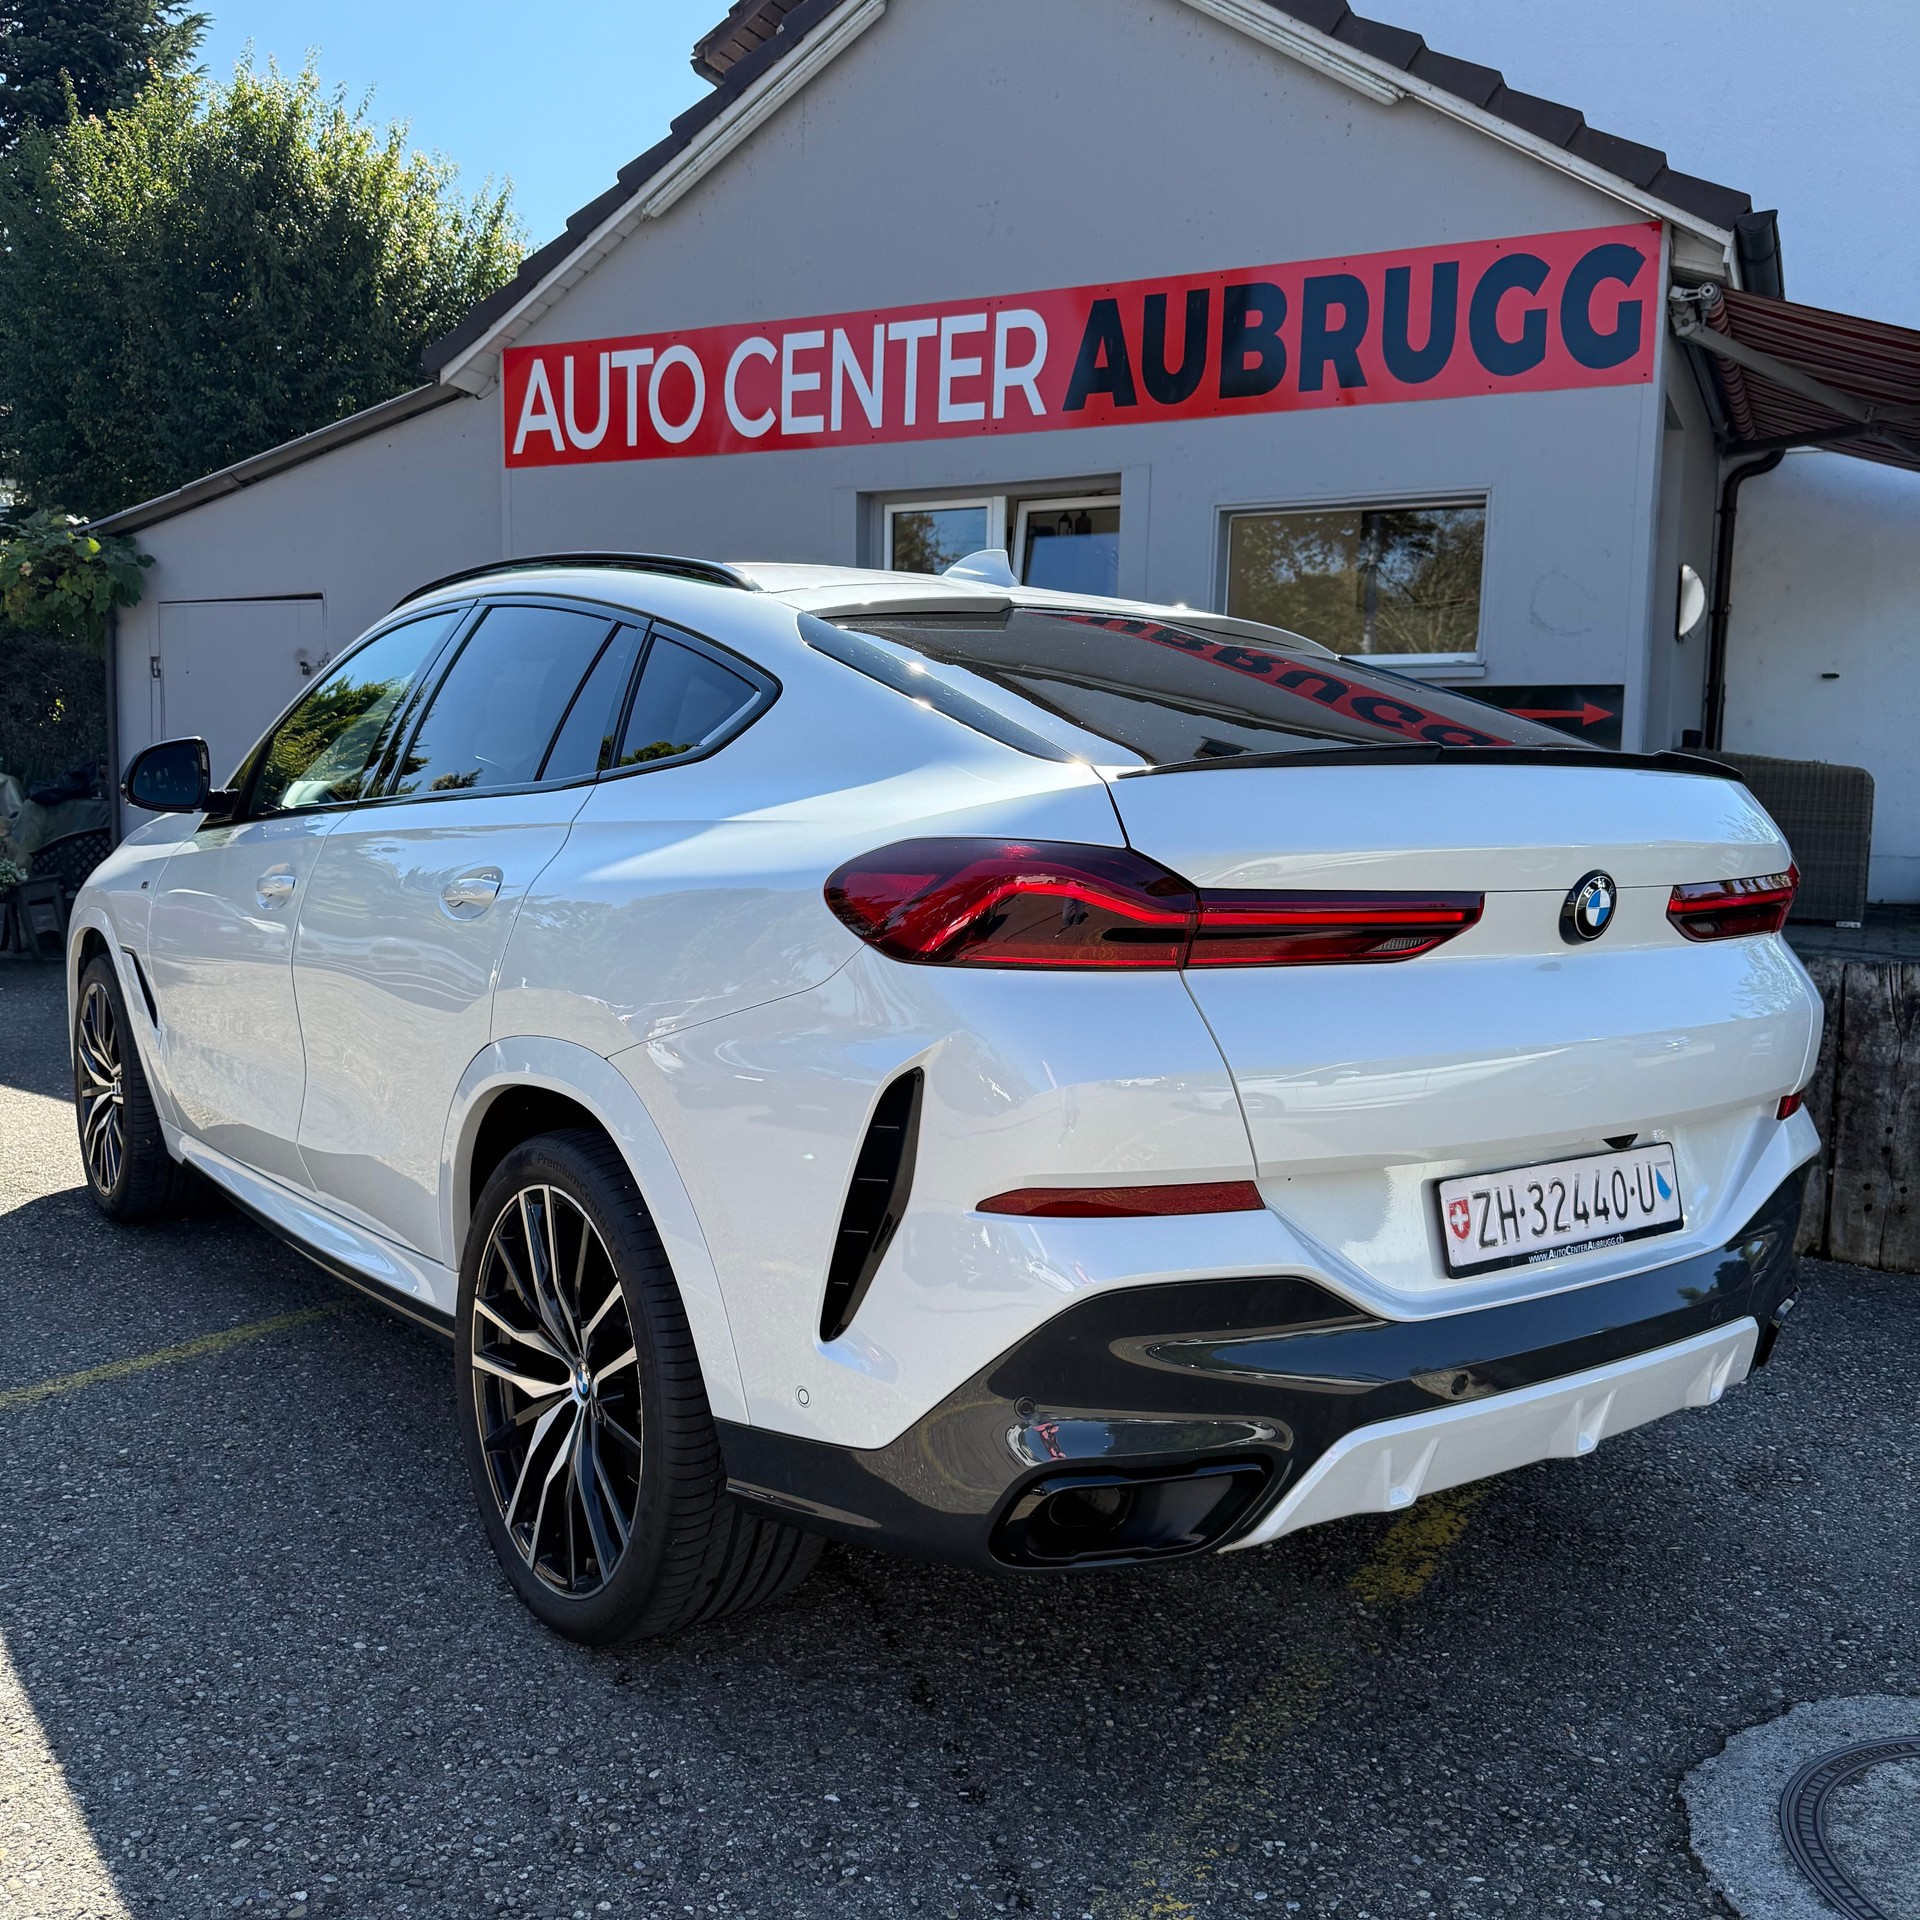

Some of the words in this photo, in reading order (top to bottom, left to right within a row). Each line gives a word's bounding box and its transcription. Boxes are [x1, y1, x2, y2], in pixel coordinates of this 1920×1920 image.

[512, 344, 705, 454] AUTO
[724, 309, 1047, 437] CENTER
[1062, 243, 1646, 411] AUBRUGG
[537, 1153, 616, 1252] PremiumContact
